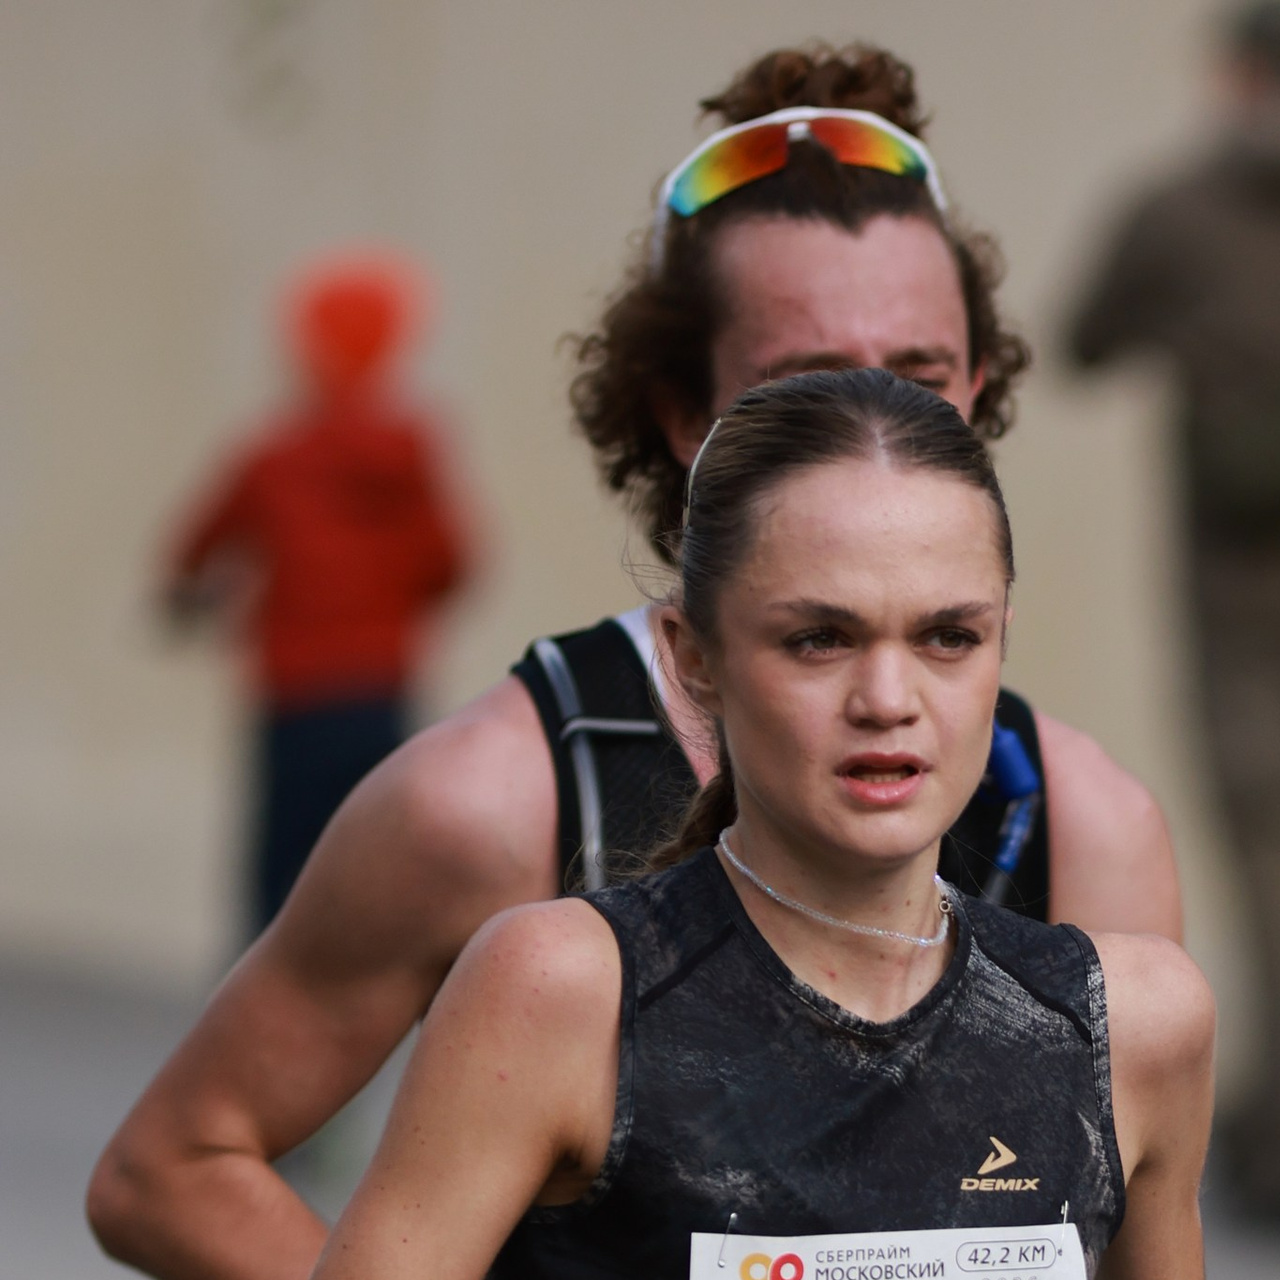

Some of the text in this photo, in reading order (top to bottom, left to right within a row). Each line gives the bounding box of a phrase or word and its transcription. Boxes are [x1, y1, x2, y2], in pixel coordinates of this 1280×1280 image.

[960, 1177, 1040, 1191] DEMIX
[815, 1245, 910, 1263] СБЕРПРАЙМ
[967, 1245, 1046, 1266] 42,2 КМ
